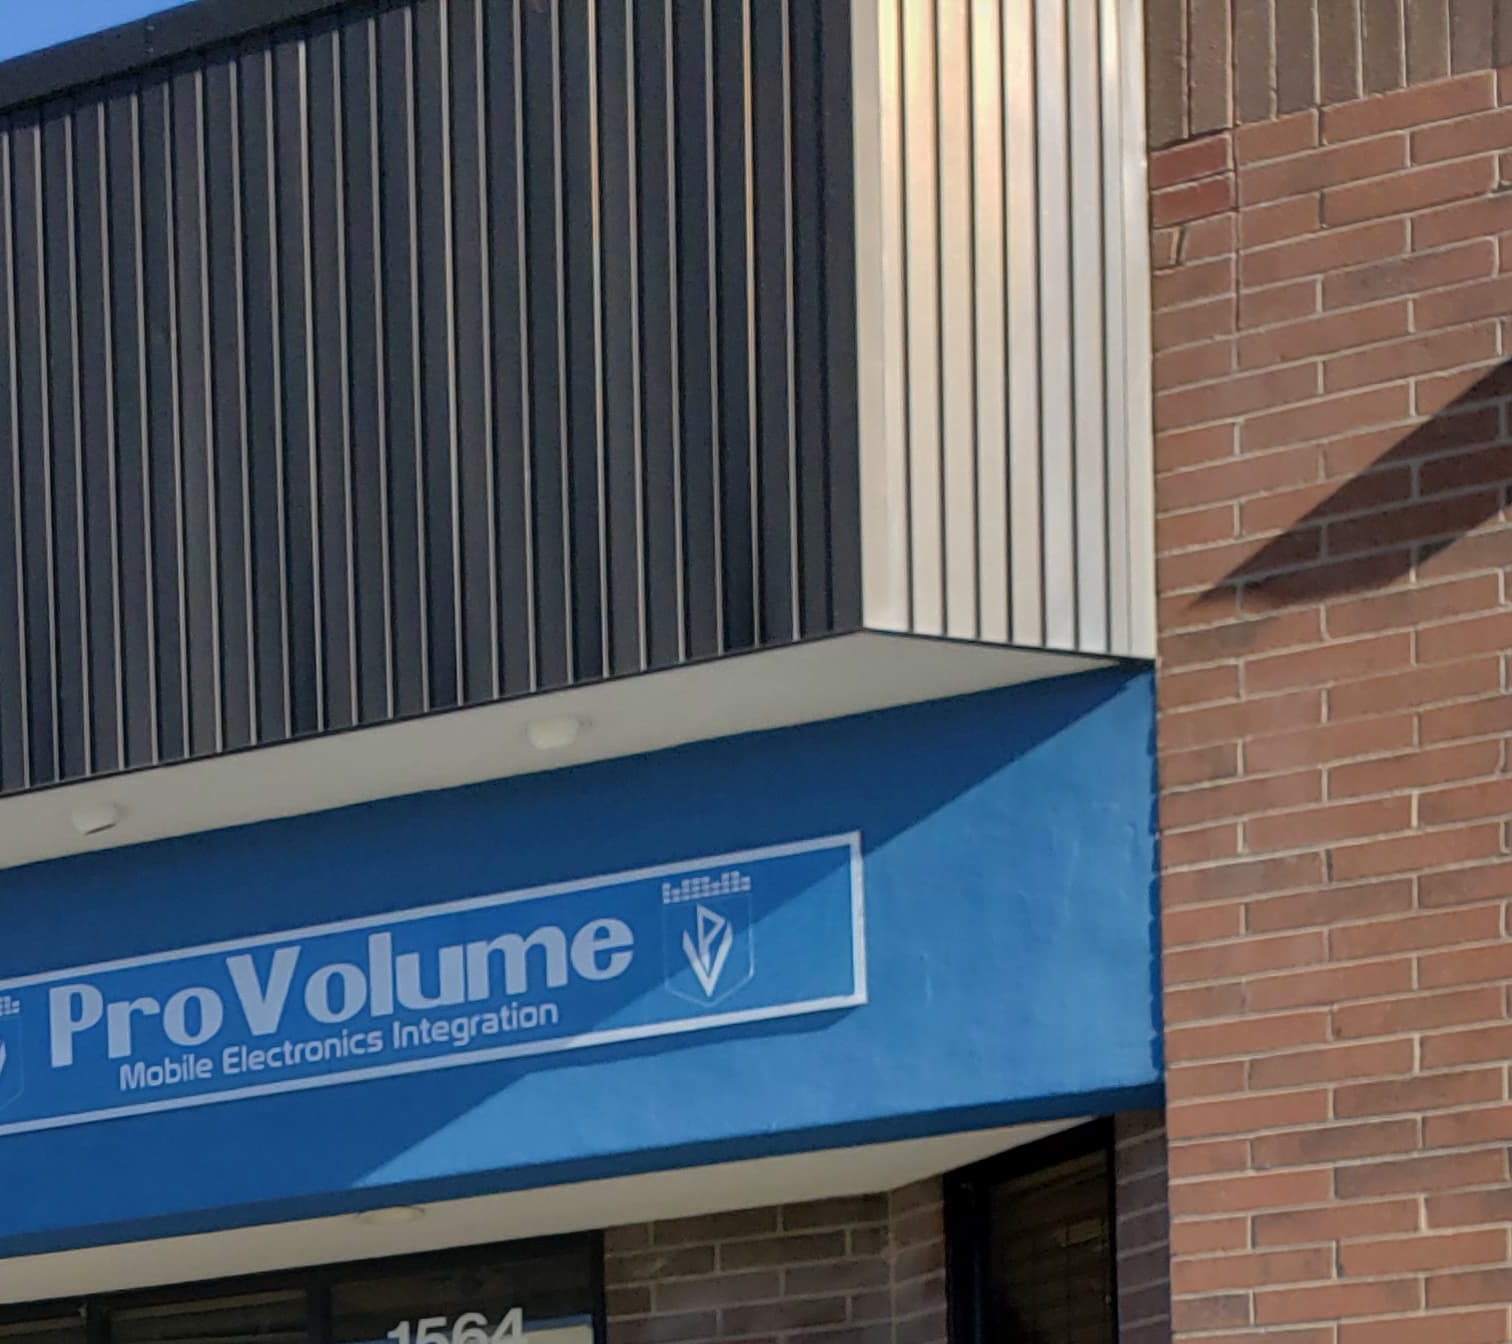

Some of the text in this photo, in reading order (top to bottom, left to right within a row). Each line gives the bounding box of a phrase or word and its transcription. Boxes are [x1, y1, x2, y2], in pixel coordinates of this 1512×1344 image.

[48, 917, 635, 1068] ProVolume
[118, 1002, 560, 1092] Mobile Electronics Integration
